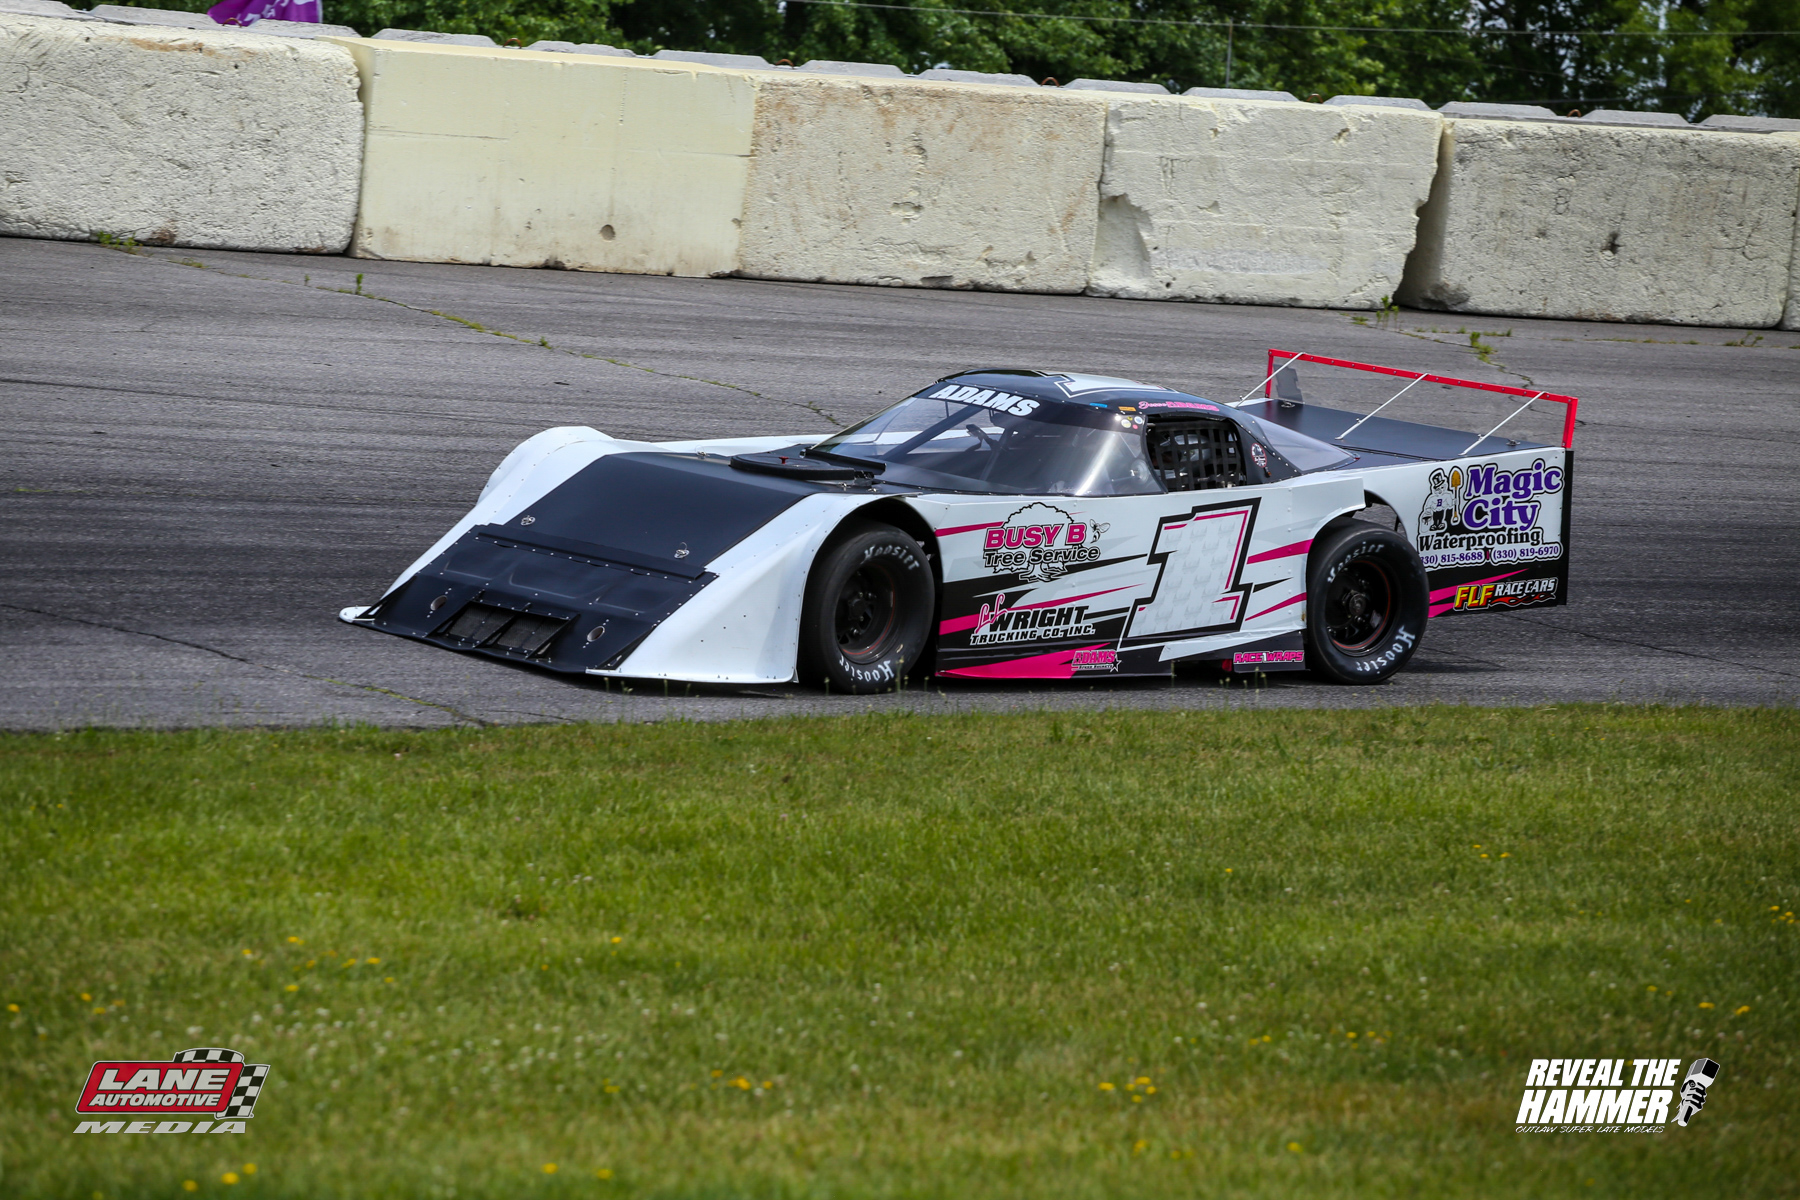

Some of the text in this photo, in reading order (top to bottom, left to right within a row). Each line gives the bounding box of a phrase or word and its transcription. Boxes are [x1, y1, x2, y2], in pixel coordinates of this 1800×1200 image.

[928, 384, 1041, 416] ADAMS
[1465, 462, 1562, 498] Magic
[1463, 499, 1539, 531] City
[984, 523, 1087, 550] BUSY B
[1418, 528, 1542, 551] Waterproofing
[984, 545, 1099, 566] Tree Service
[1441, 551, 1483, 563] 815-8688
[1493, 548, 1517, 560] (330)
[1519, 545, 1559, 558] 819-6970
[1122, 497, 1262, 640] 1
[1453, 578, 1556, 609] FLF RACE CARS
[989, 605, 1090, 633] WRIGHT
[971, 623, 1096, 645] TRUCKING CO. INC.
[1072, 650, 1117, 665] ADAMS
[1356, 625, 1416, 674] Hoosier
[839, 655, 895, 683] Hoosier
